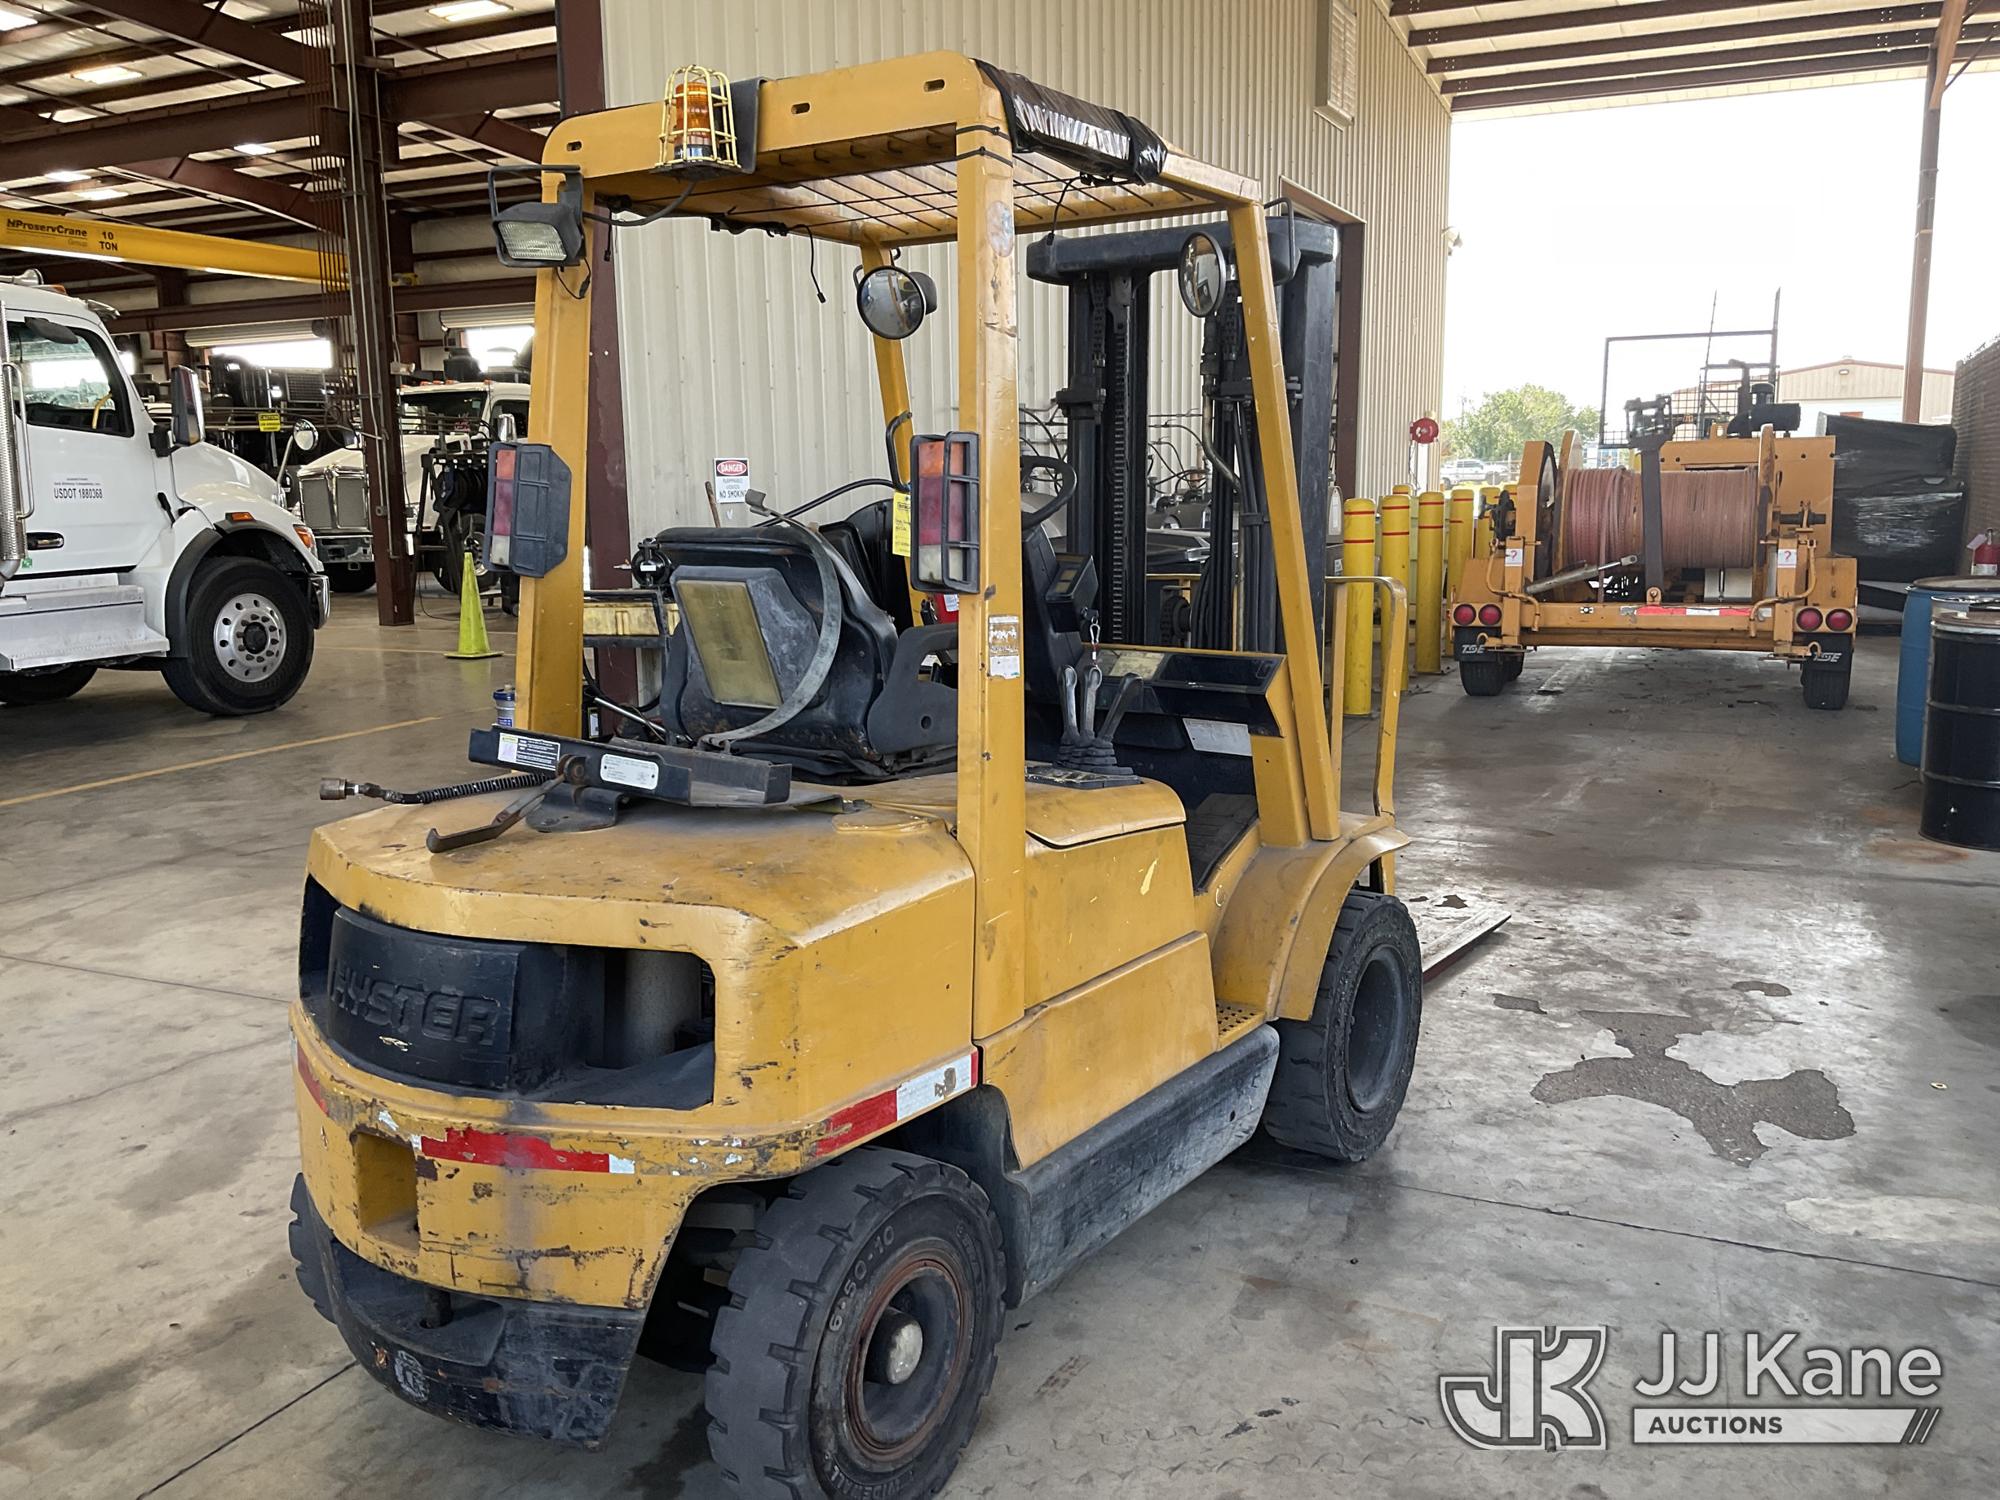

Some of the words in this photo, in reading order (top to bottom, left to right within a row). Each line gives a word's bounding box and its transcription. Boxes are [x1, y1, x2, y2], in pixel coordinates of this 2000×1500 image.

[102, 231, 114, 240] 10
[99, 241, 118, 251] TON
[54, 488, 77, 499] USDOT
[719, 490, 727, 499] NO
[728, 490, 747, 499] SMOKIN
